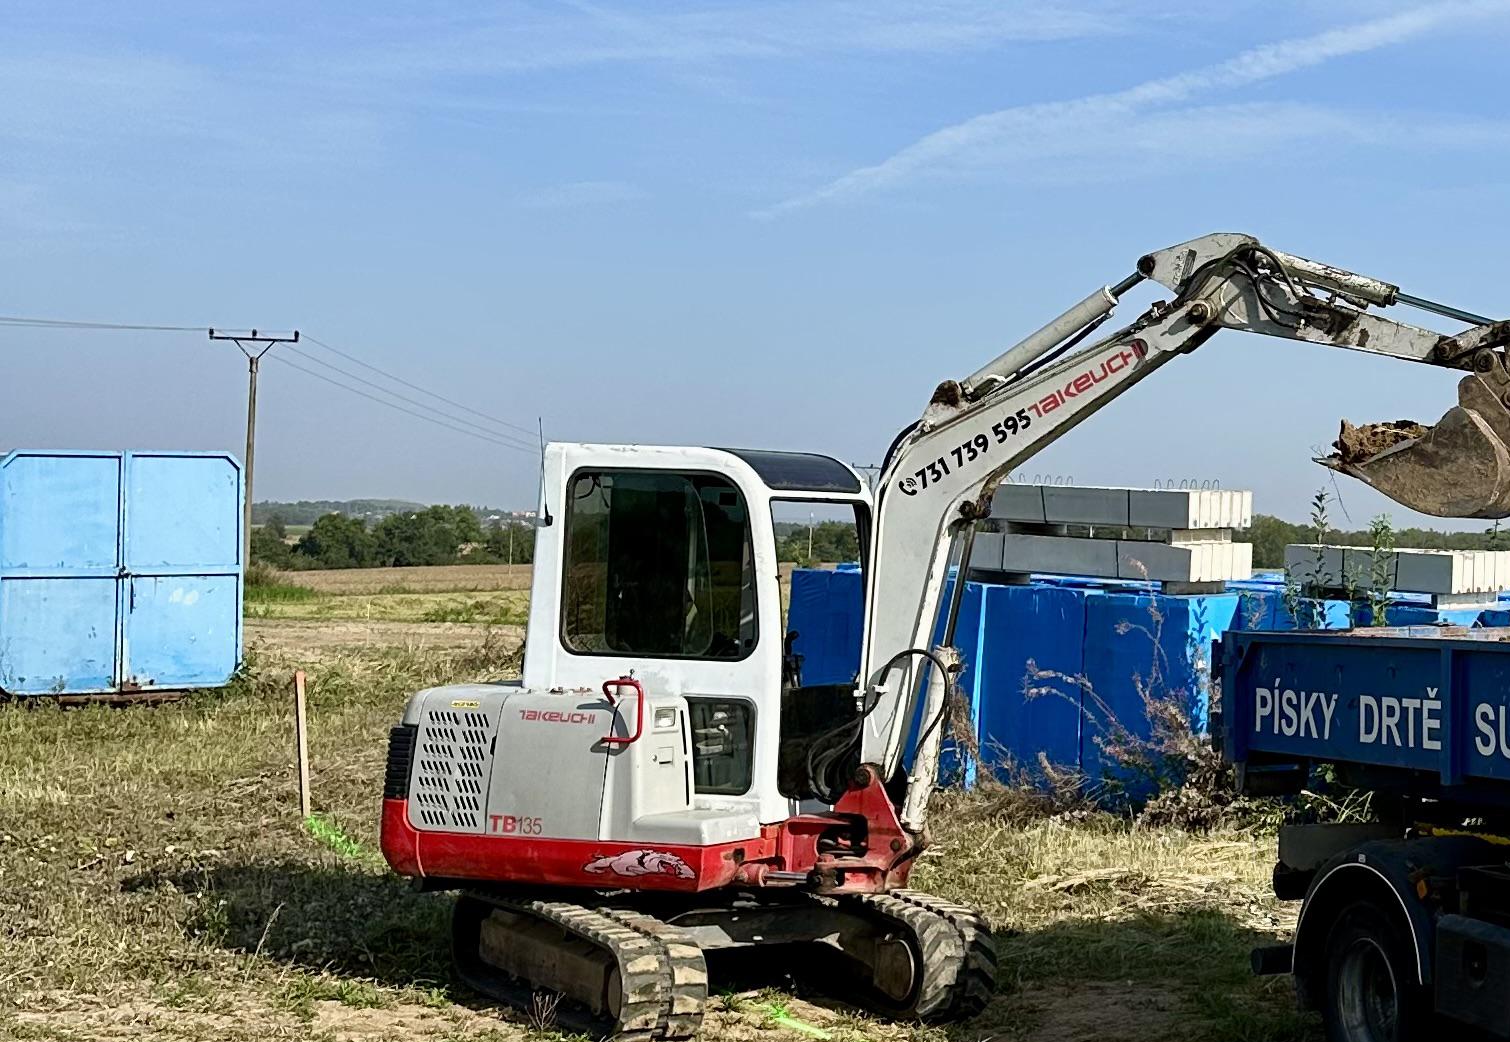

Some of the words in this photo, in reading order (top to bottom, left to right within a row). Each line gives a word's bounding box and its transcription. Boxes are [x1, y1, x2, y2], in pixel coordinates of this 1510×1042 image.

[1027, 341, 1146, 418] TAKEUCHI
[914, 456, 951, 490] 731
[950, 433, 989, 469] 739
[991, 408, 1032, 445] 595
[519, 709, 596, 725] TAKEUCHI
[1255, 677, 1339, 741] PÍSKY
[1359, 686, 1442, 751] DRTĚ
[489, 814, 543, 836] TB135
